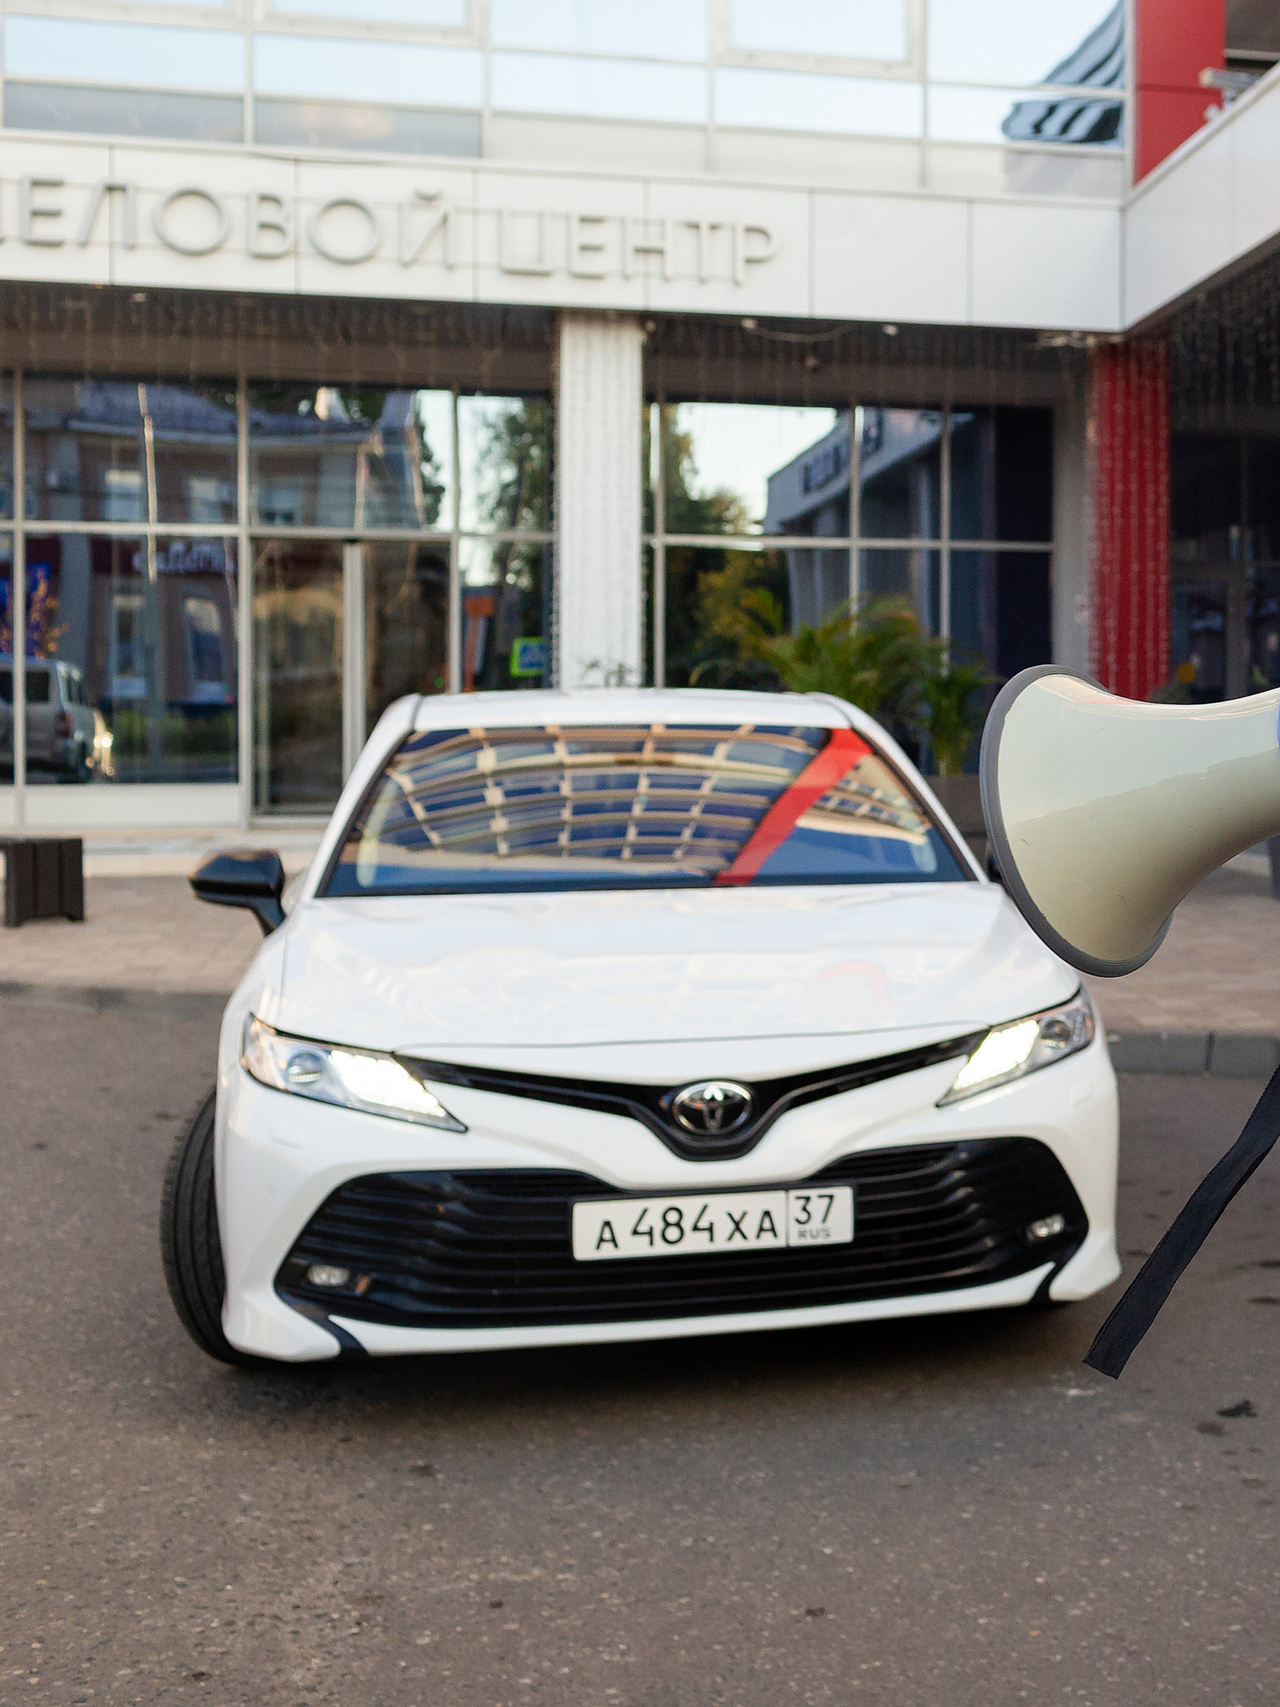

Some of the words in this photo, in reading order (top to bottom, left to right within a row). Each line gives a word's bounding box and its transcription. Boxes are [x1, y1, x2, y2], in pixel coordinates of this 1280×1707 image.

[0, 177, 456, 270] ЕЛОВОЙ
[498, 207, 778, 287] ЦЕНТР
[795, 1194, 834, 1225] 37
[797, 1227, 832, 1241] RUS
